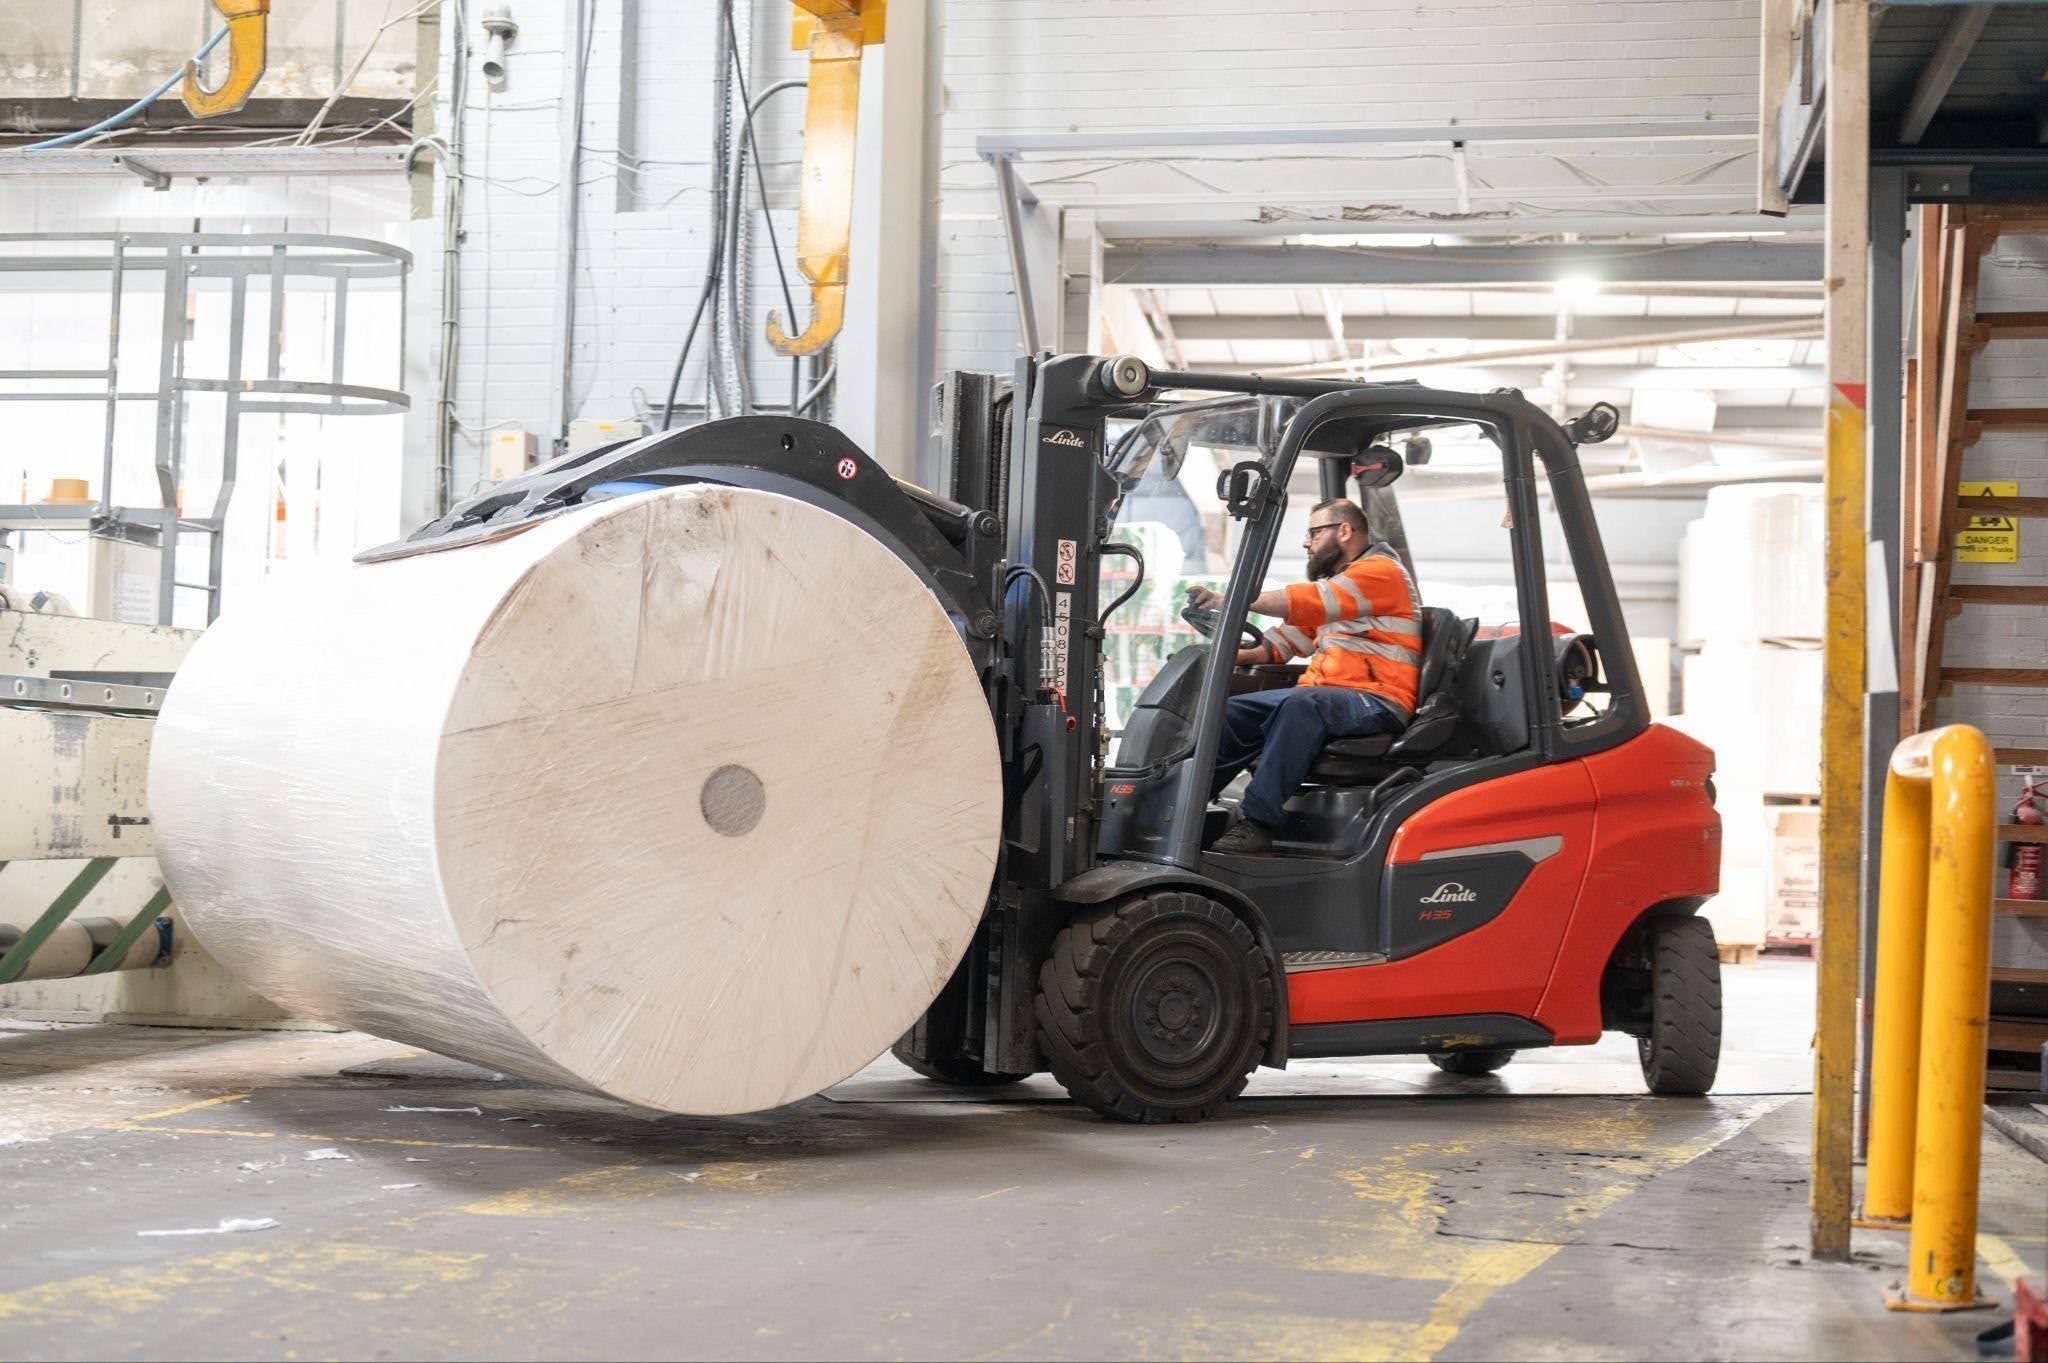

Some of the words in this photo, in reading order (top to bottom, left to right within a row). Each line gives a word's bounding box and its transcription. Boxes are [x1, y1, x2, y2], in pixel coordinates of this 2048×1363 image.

[1042, 430, 1085, 448] Linde
[1965, 536, 2009, 544] DANGER
[1420, 882, 1477, 903] Linde
[1419, 909, 1454, 921] H35
